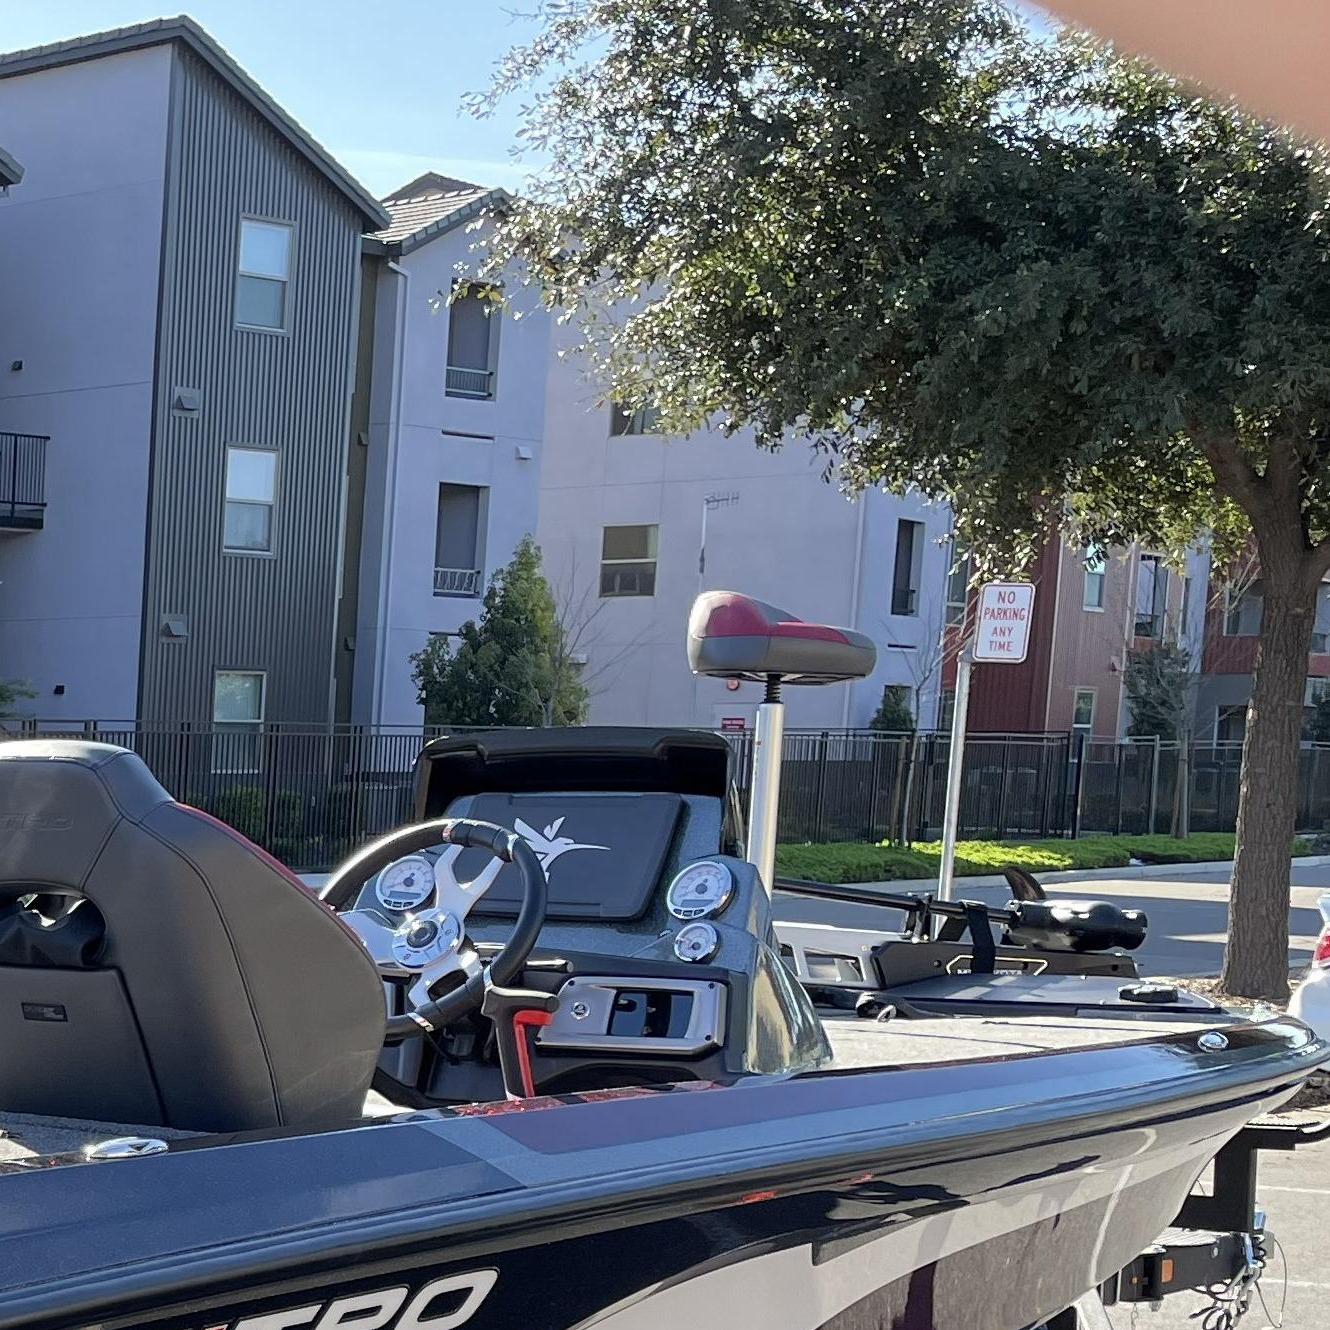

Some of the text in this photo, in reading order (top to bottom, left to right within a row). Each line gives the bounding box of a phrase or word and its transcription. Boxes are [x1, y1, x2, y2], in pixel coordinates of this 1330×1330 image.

[997, 591, 1016, 604] NO
[983, 607, 1026, 621] PARKING
[991, 627, 1014, 636] ANY
[989, 640, 1013, 652] TIME
